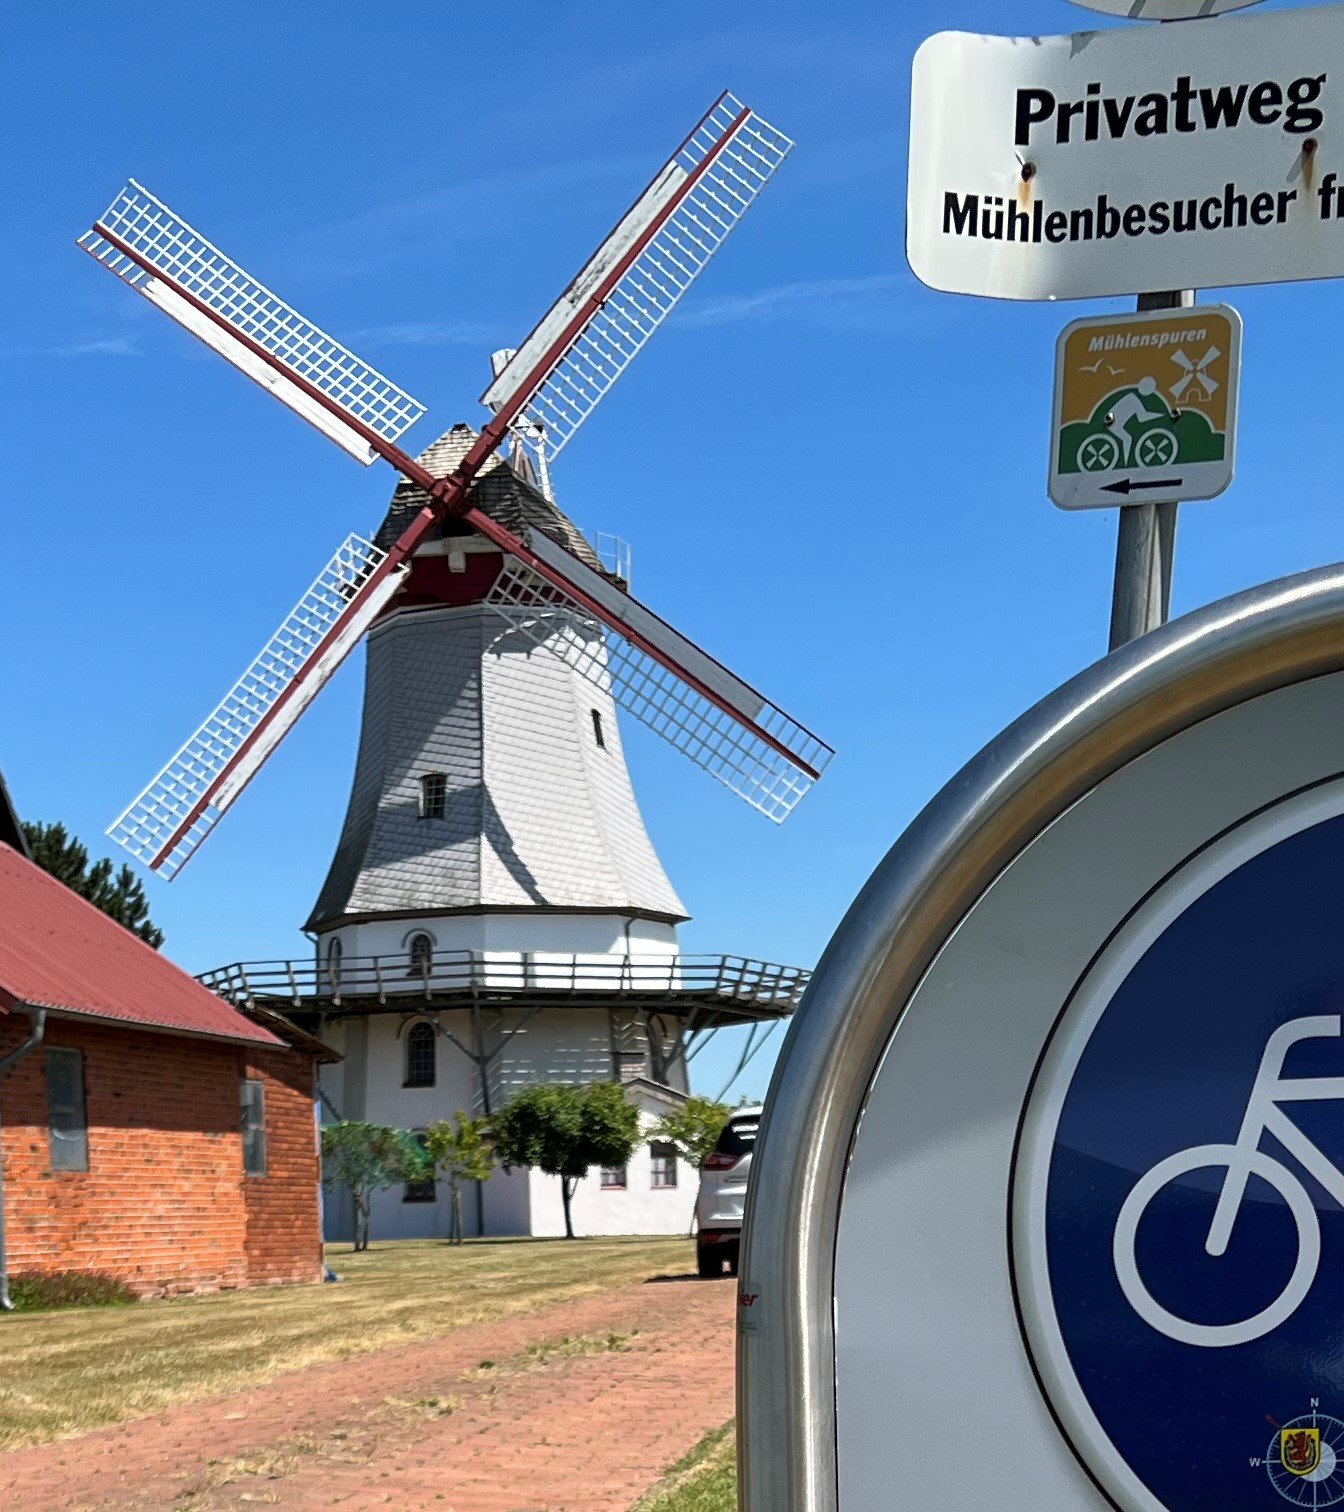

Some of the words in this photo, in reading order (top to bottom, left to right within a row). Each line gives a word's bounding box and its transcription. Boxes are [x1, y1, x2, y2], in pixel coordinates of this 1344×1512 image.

[1014, 72, 1327, 146] Privatweg
[942, 182, 1298, 243] Mühlenbesucher
[1088, 328, 1207, 352] Mühlenspuren
[1310, 1397, 1319, 1407] N
[1249, 1457, 1261, 1467] W
